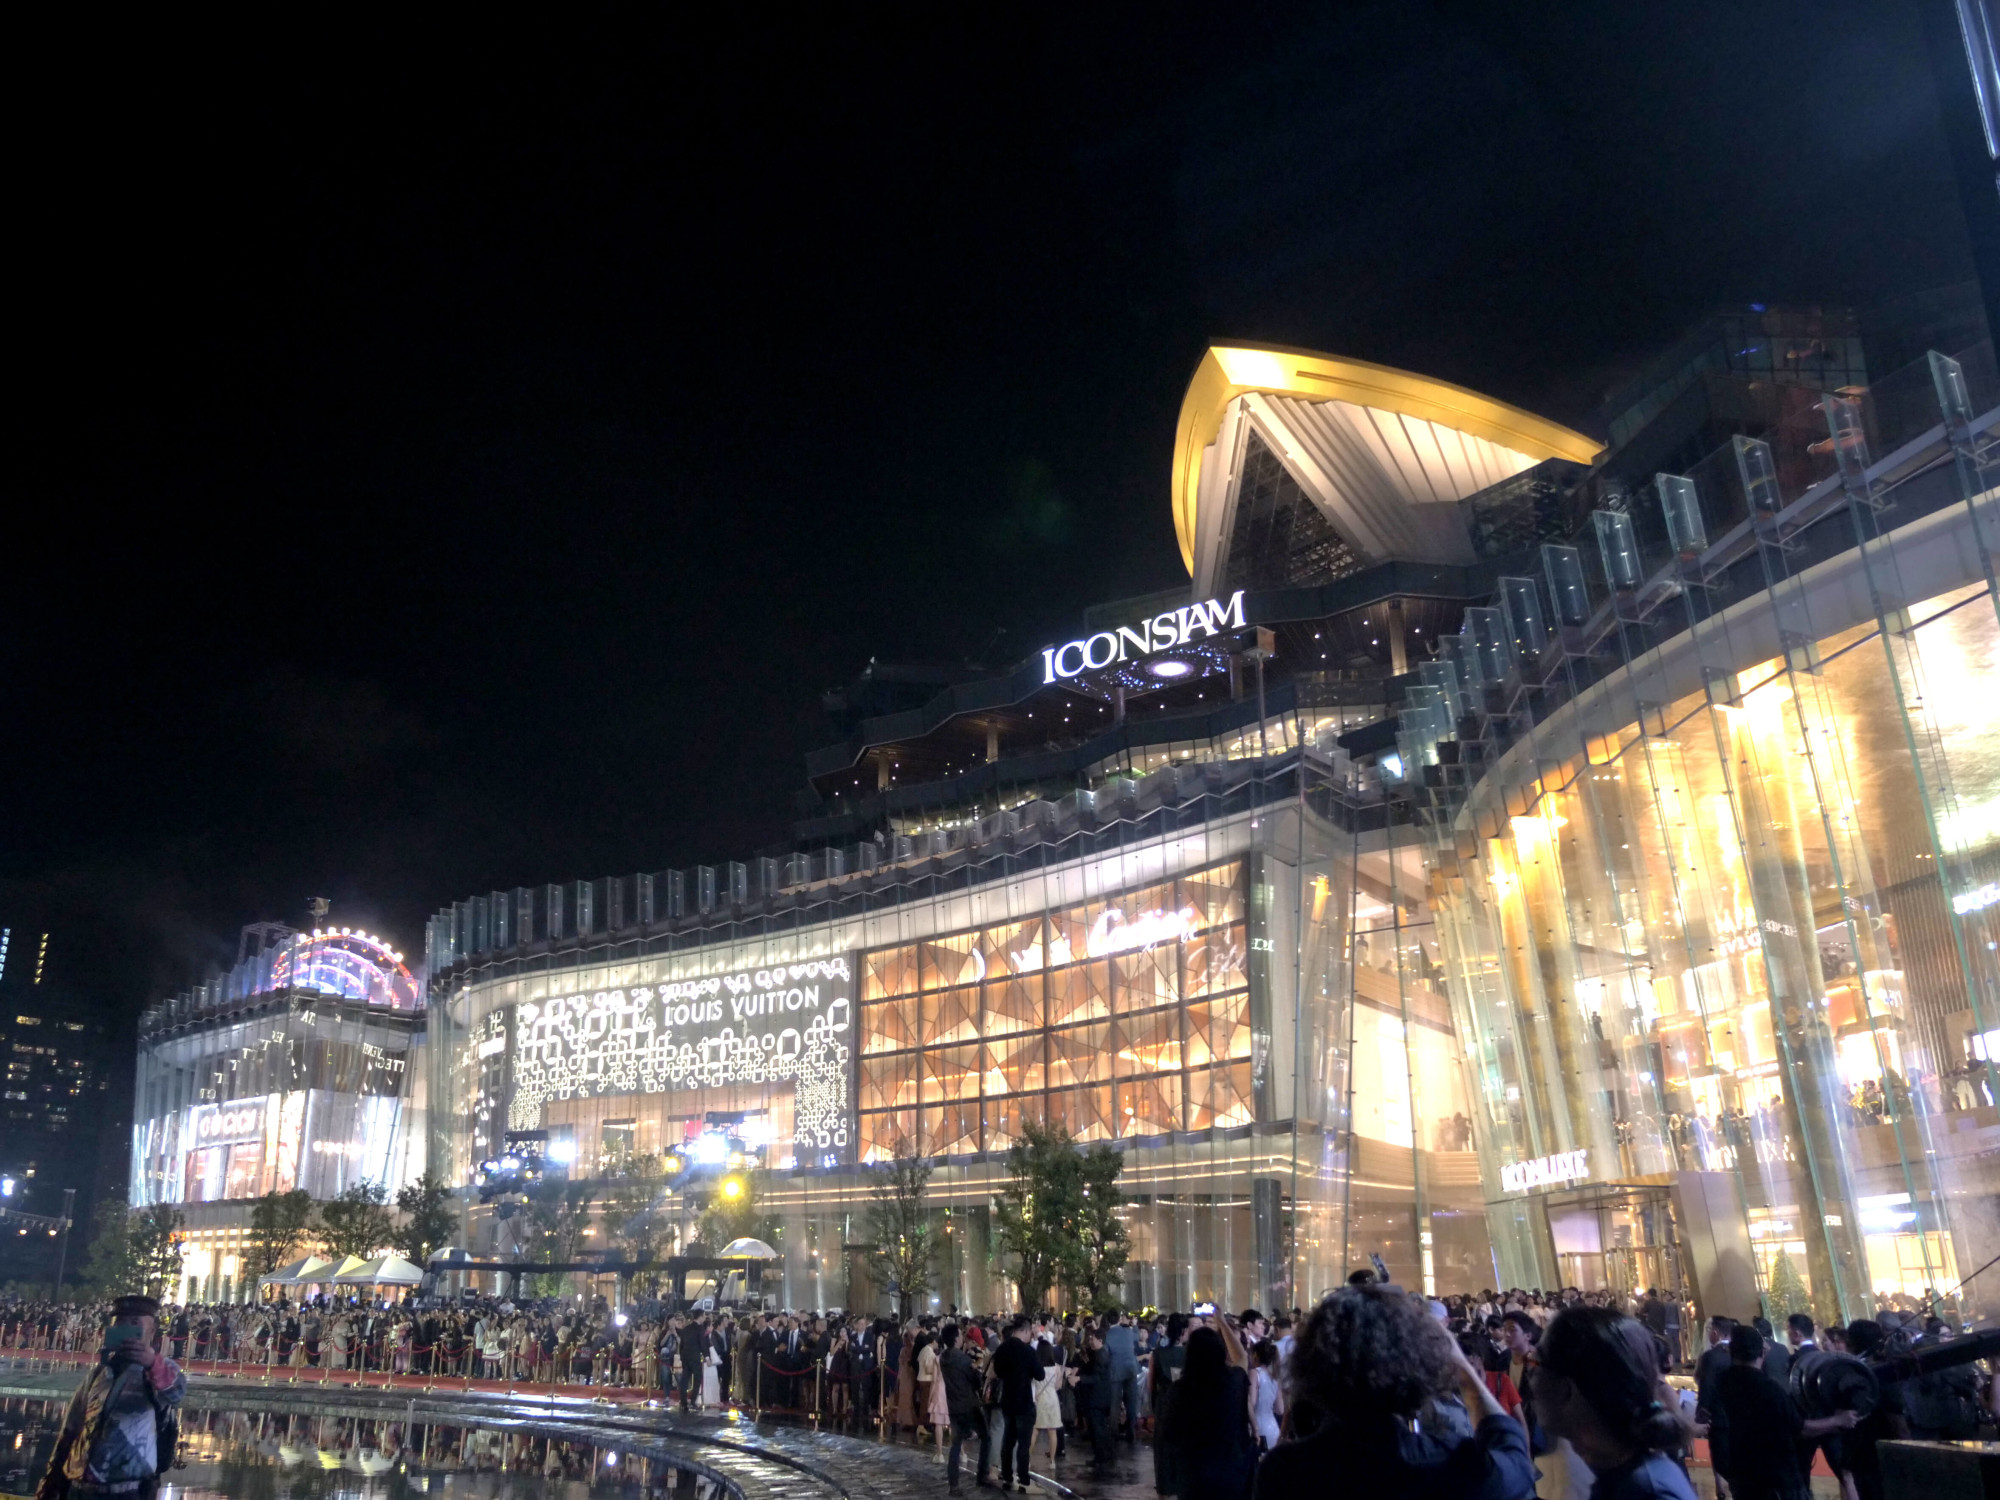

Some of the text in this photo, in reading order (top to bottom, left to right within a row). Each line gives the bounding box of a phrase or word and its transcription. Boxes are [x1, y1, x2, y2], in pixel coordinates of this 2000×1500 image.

[1042, 590, 1246, 684] ICONSIAM
[665, 985, 819, 1027] LOUIS VUITTON
